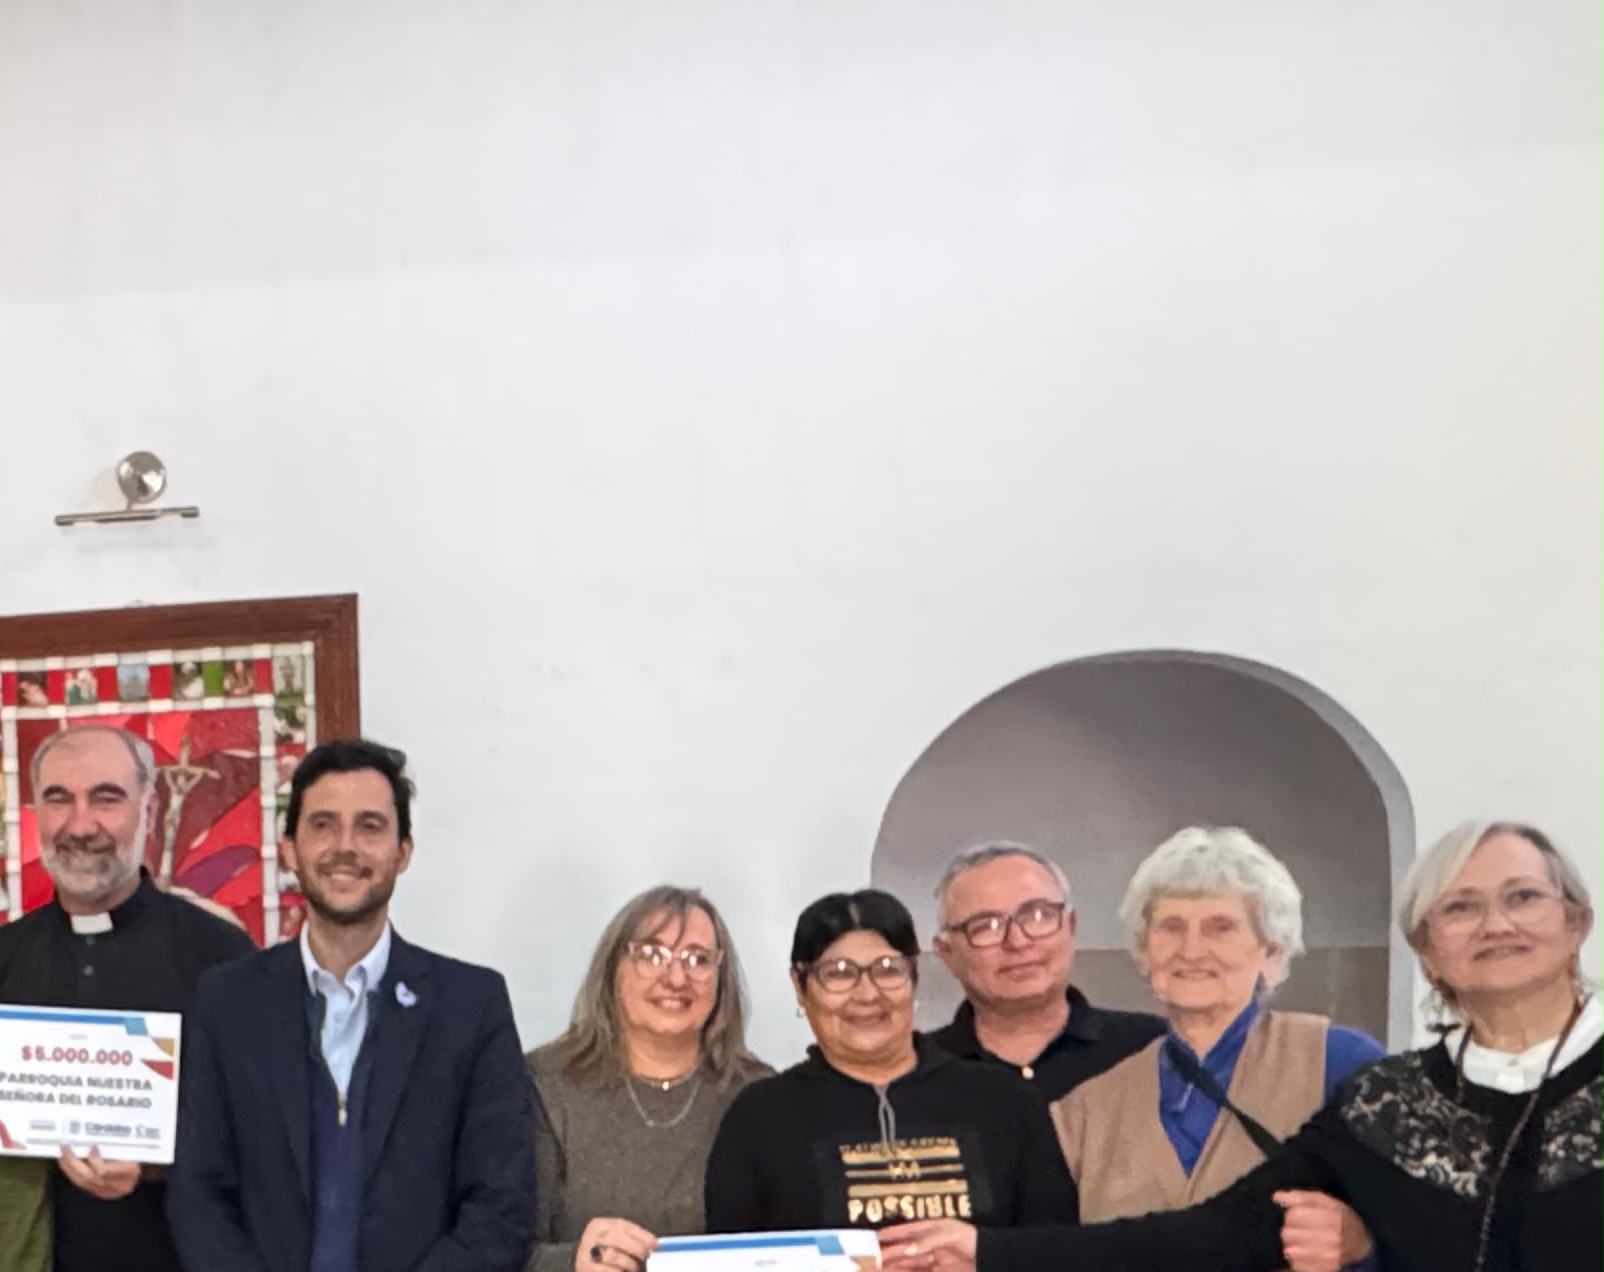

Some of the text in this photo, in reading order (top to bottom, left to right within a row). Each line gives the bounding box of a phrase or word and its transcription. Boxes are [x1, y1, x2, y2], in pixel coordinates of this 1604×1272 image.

[21, 1045, 133, 1066] $5.000.000
[87, 1076, 153, 1091] NUESTRA
[58, 1093, 83, 1106] DEL
[86, 1095, 153, 1109] ROSARIO
